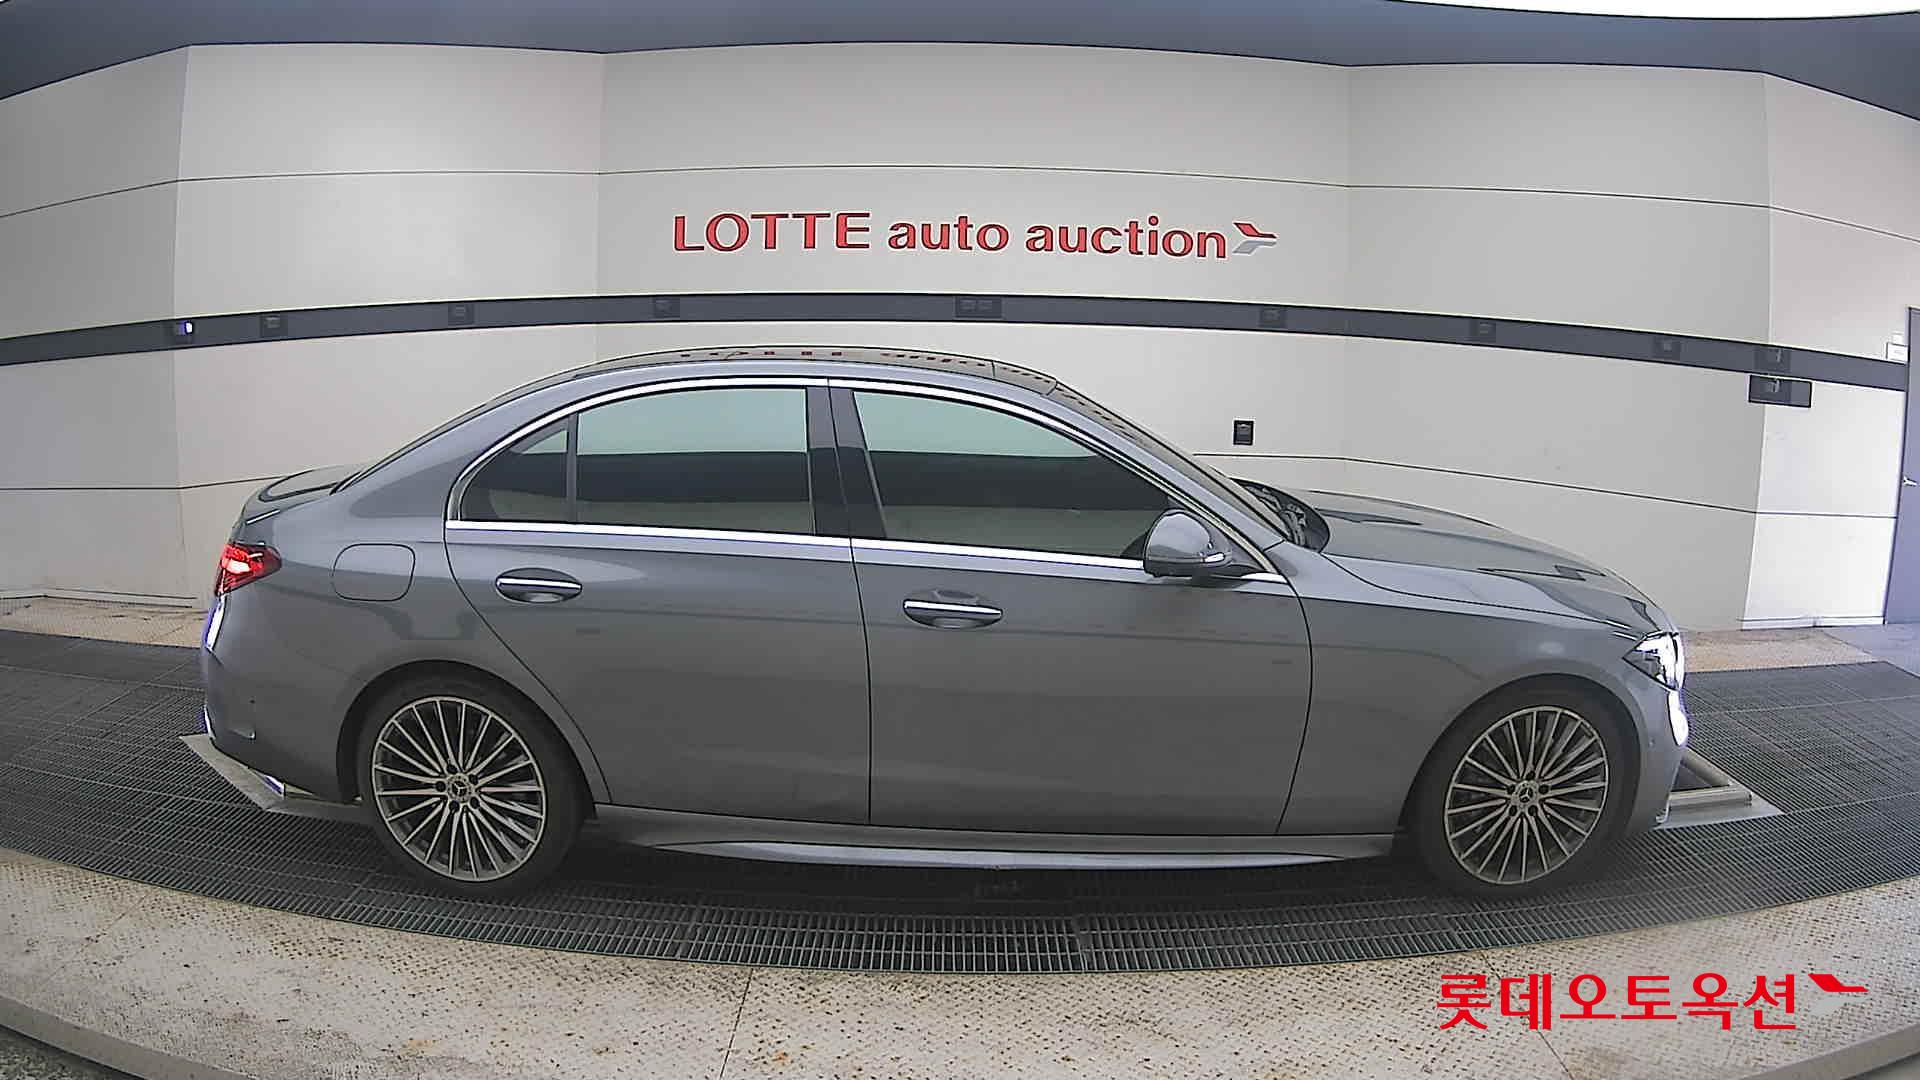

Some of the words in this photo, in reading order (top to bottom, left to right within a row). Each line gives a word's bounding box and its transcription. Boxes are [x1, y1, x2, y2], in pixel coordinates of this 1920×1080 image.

[673, 212, 870, 252] LOTTE
[887, 215, 1009, 252] auto
[1025, 216, 1227, 258] auction
